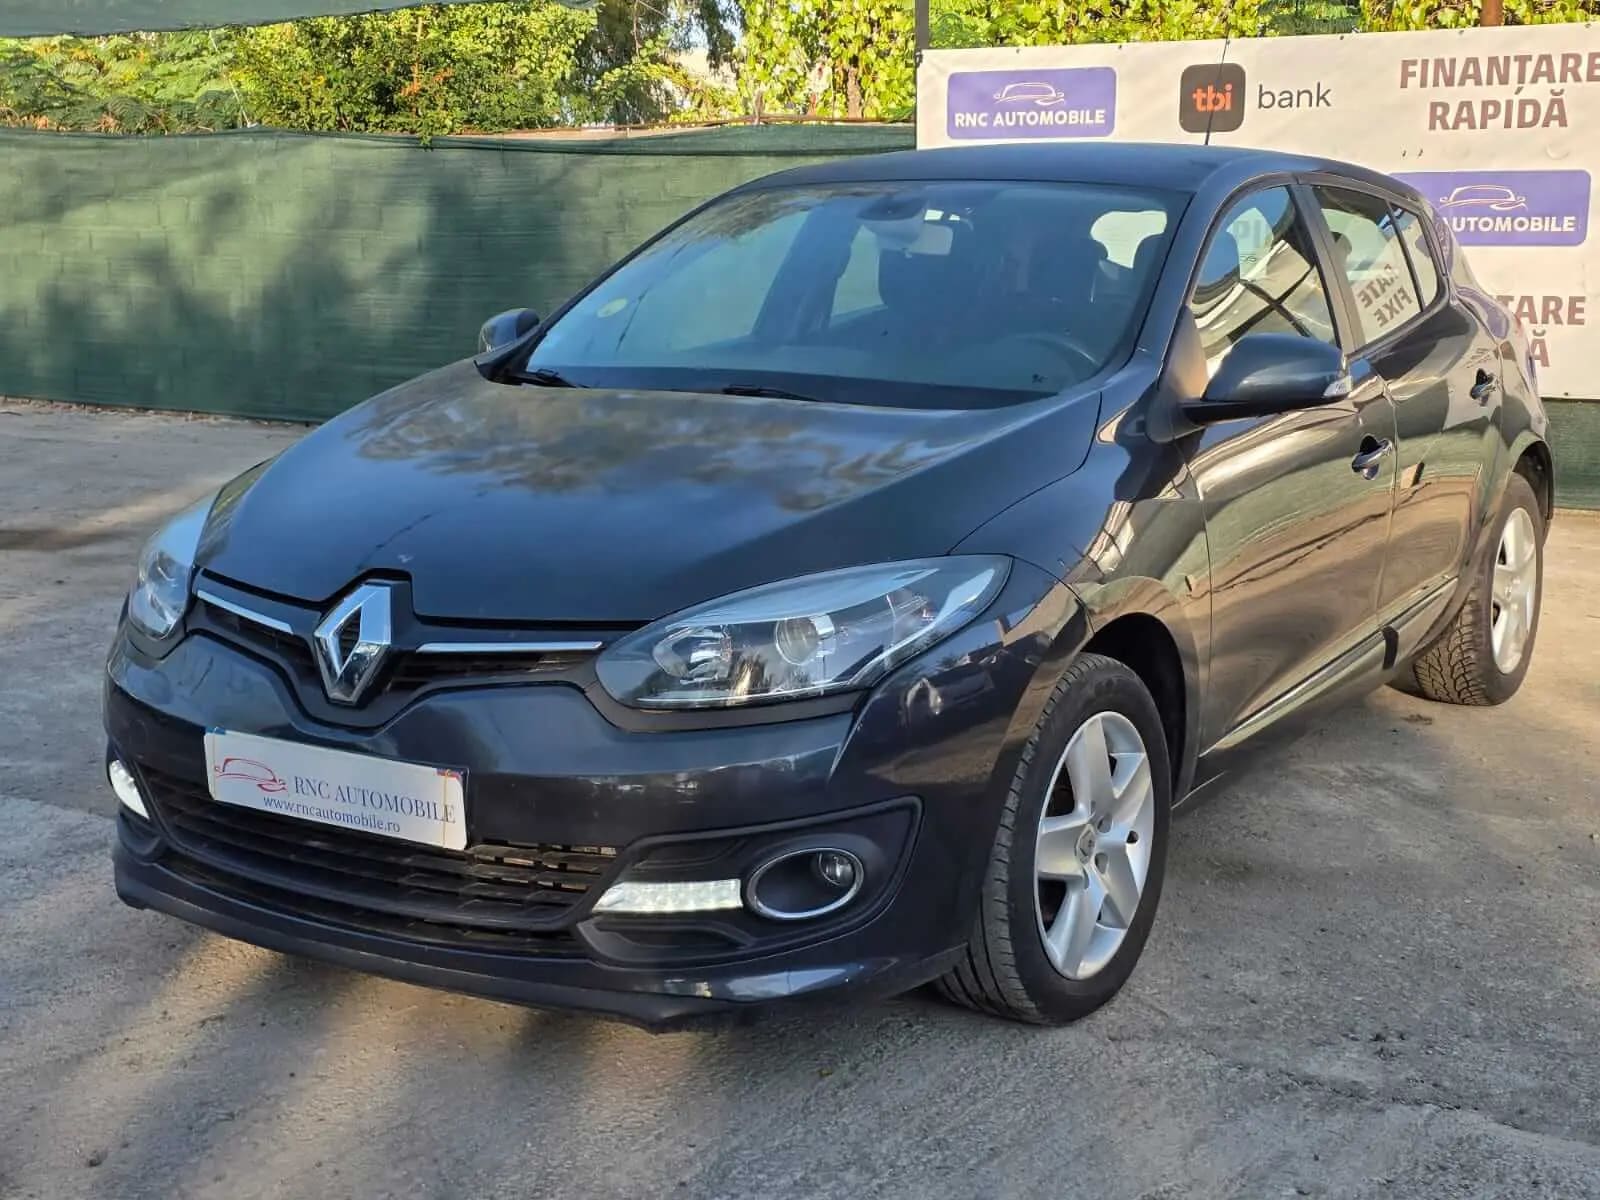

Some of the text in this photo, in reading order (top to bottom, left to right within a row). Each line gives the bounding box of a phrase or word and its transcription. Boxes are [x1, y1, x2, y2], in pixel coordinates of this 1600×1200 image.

[1192, 82, 1331, 112] tbi bank
[1428, 88, 1568, 131] RAPIDĂ
[954, 110, 1105, 128] RNC AUTOMOBILE
[263, 795, 401, 833] www.rncautomobile.ro
[293, 775, 457, 824] RNC AUTOMOBILE
